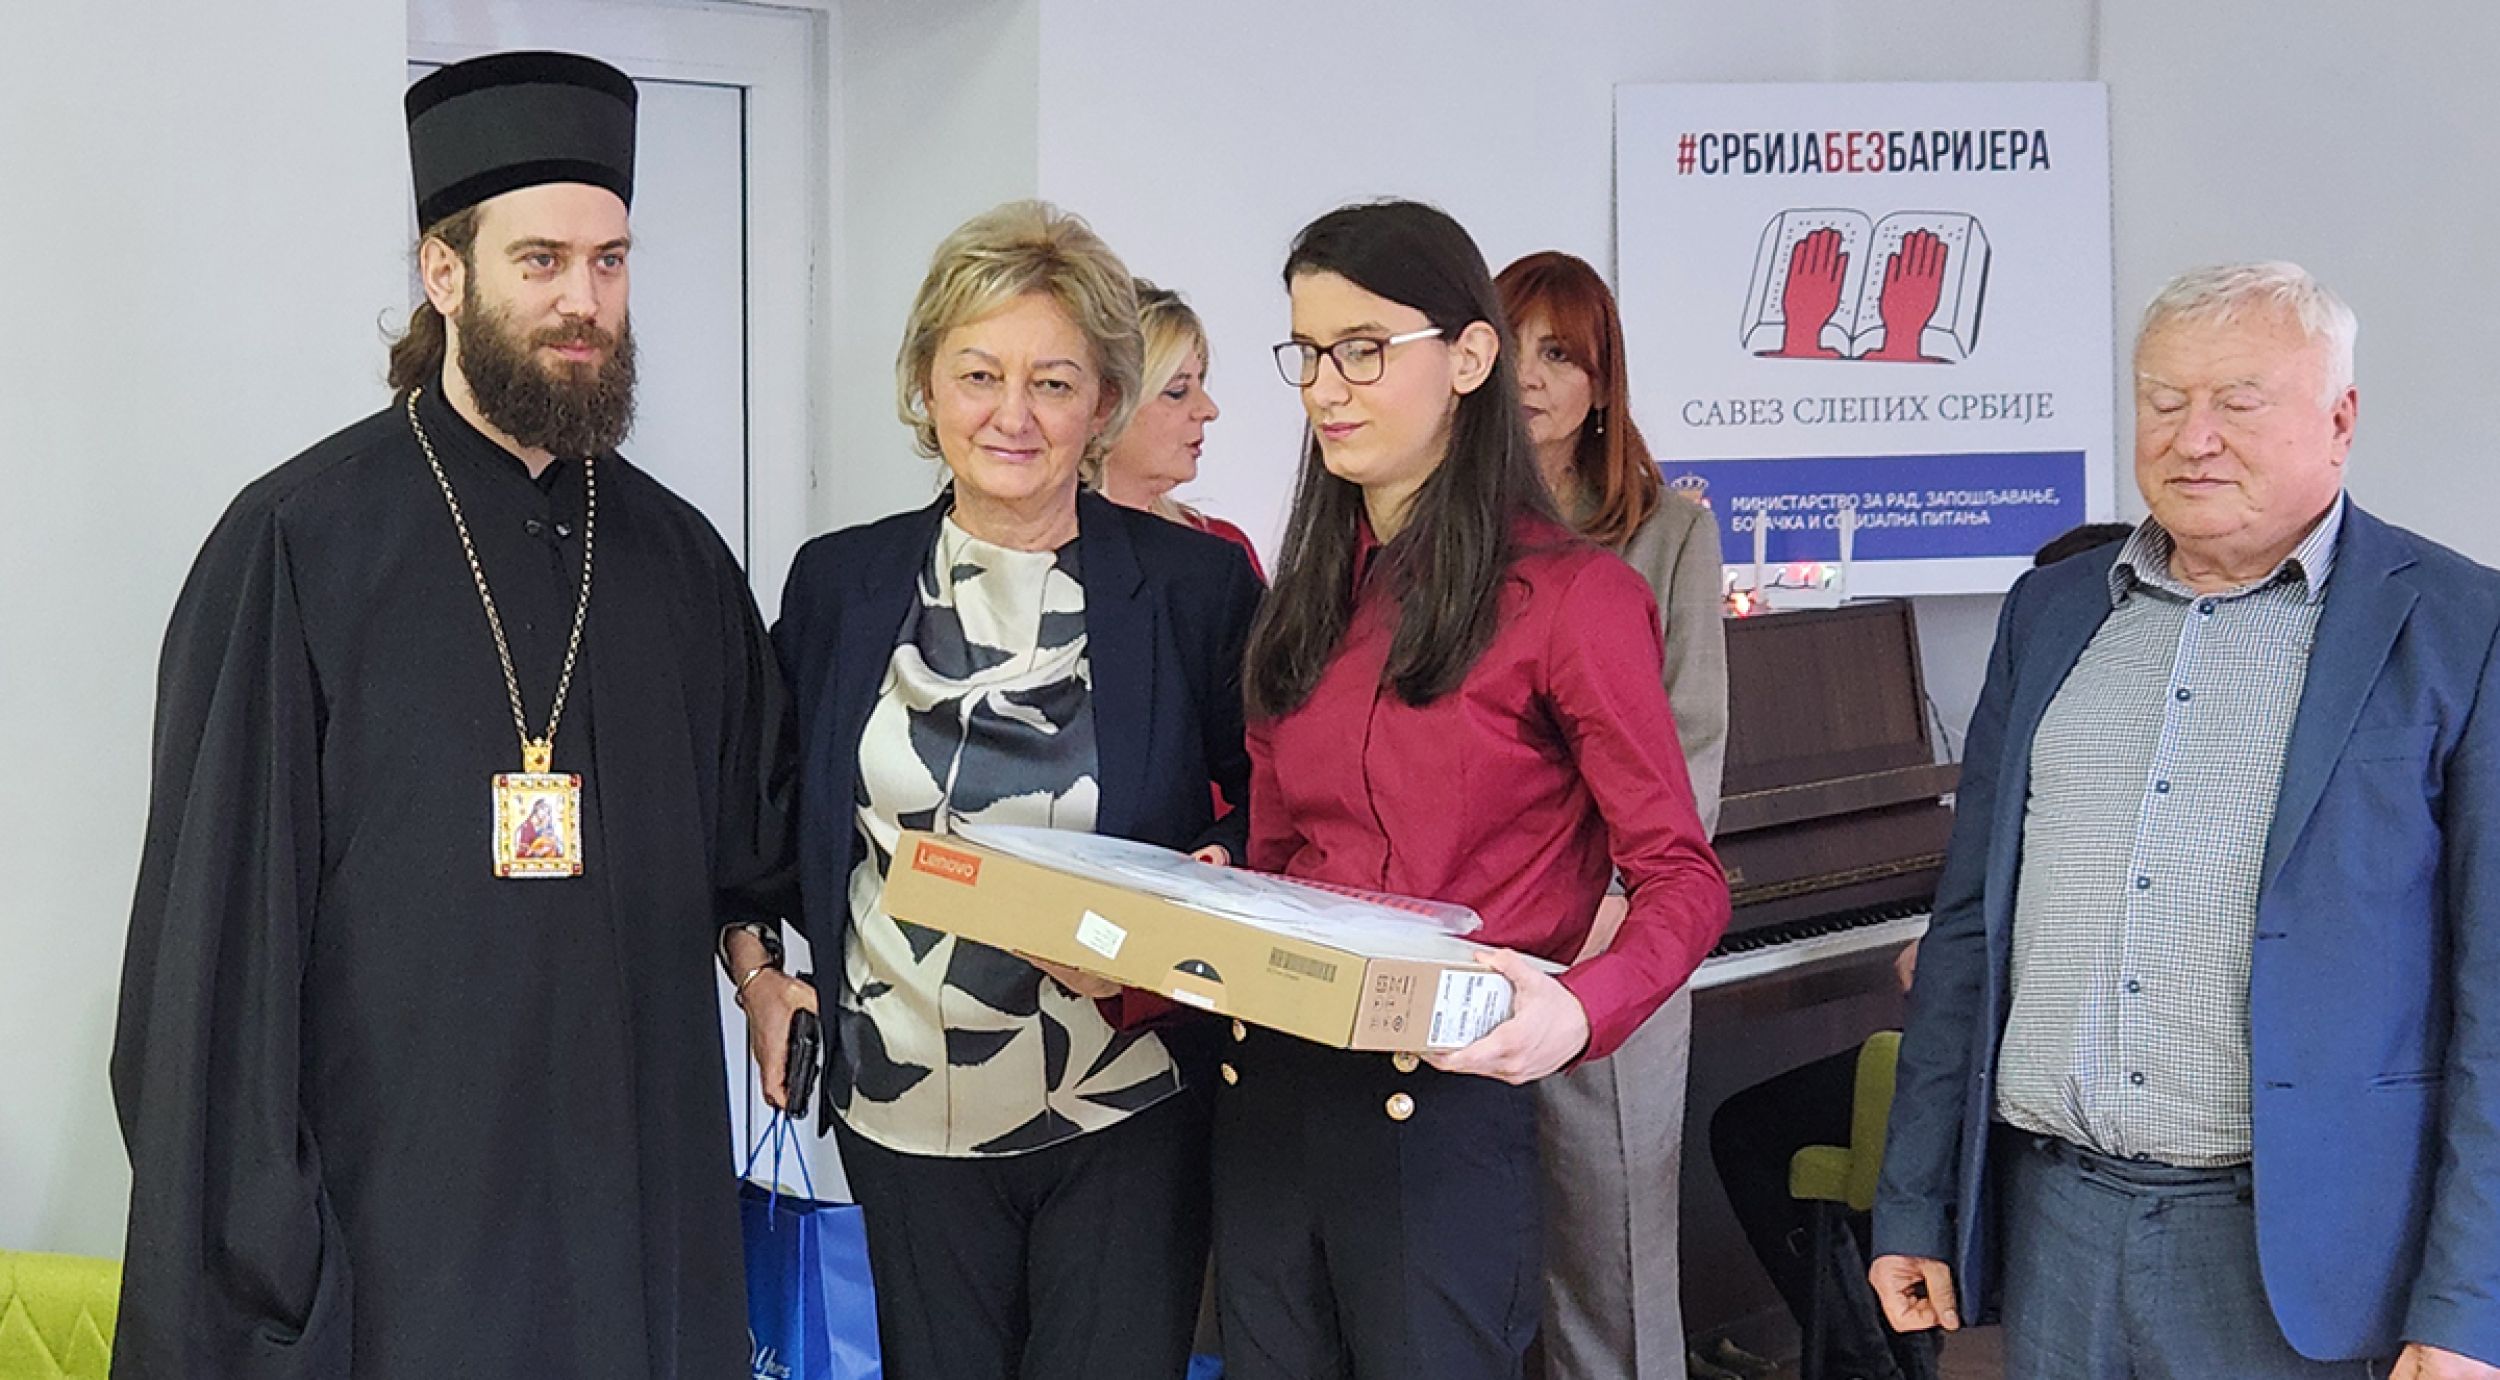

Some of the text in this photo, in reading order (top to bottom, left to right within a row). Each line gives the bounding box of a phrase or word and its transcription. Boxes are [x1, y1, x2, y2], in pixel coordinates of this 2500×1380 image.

[1677, 129, 2051, 175] #СРБИЈАБЕЗБАРИЈЕРА
[1682, 392, 2055, 427] САВЕЗ СЛЕПИХ СРБИЈЕ
[1731, 492, 1858, 511] МИНИСТАРСТВО
[1863, 491, 1883, 509] ЗА
[1732, 513, 1805, 532] БОАЧКА
[1807, 513, 1821, 530] И
[1922, 509, 1991, 527] ПИТАЊА
[918, 847, 975, 879] Lenovo
